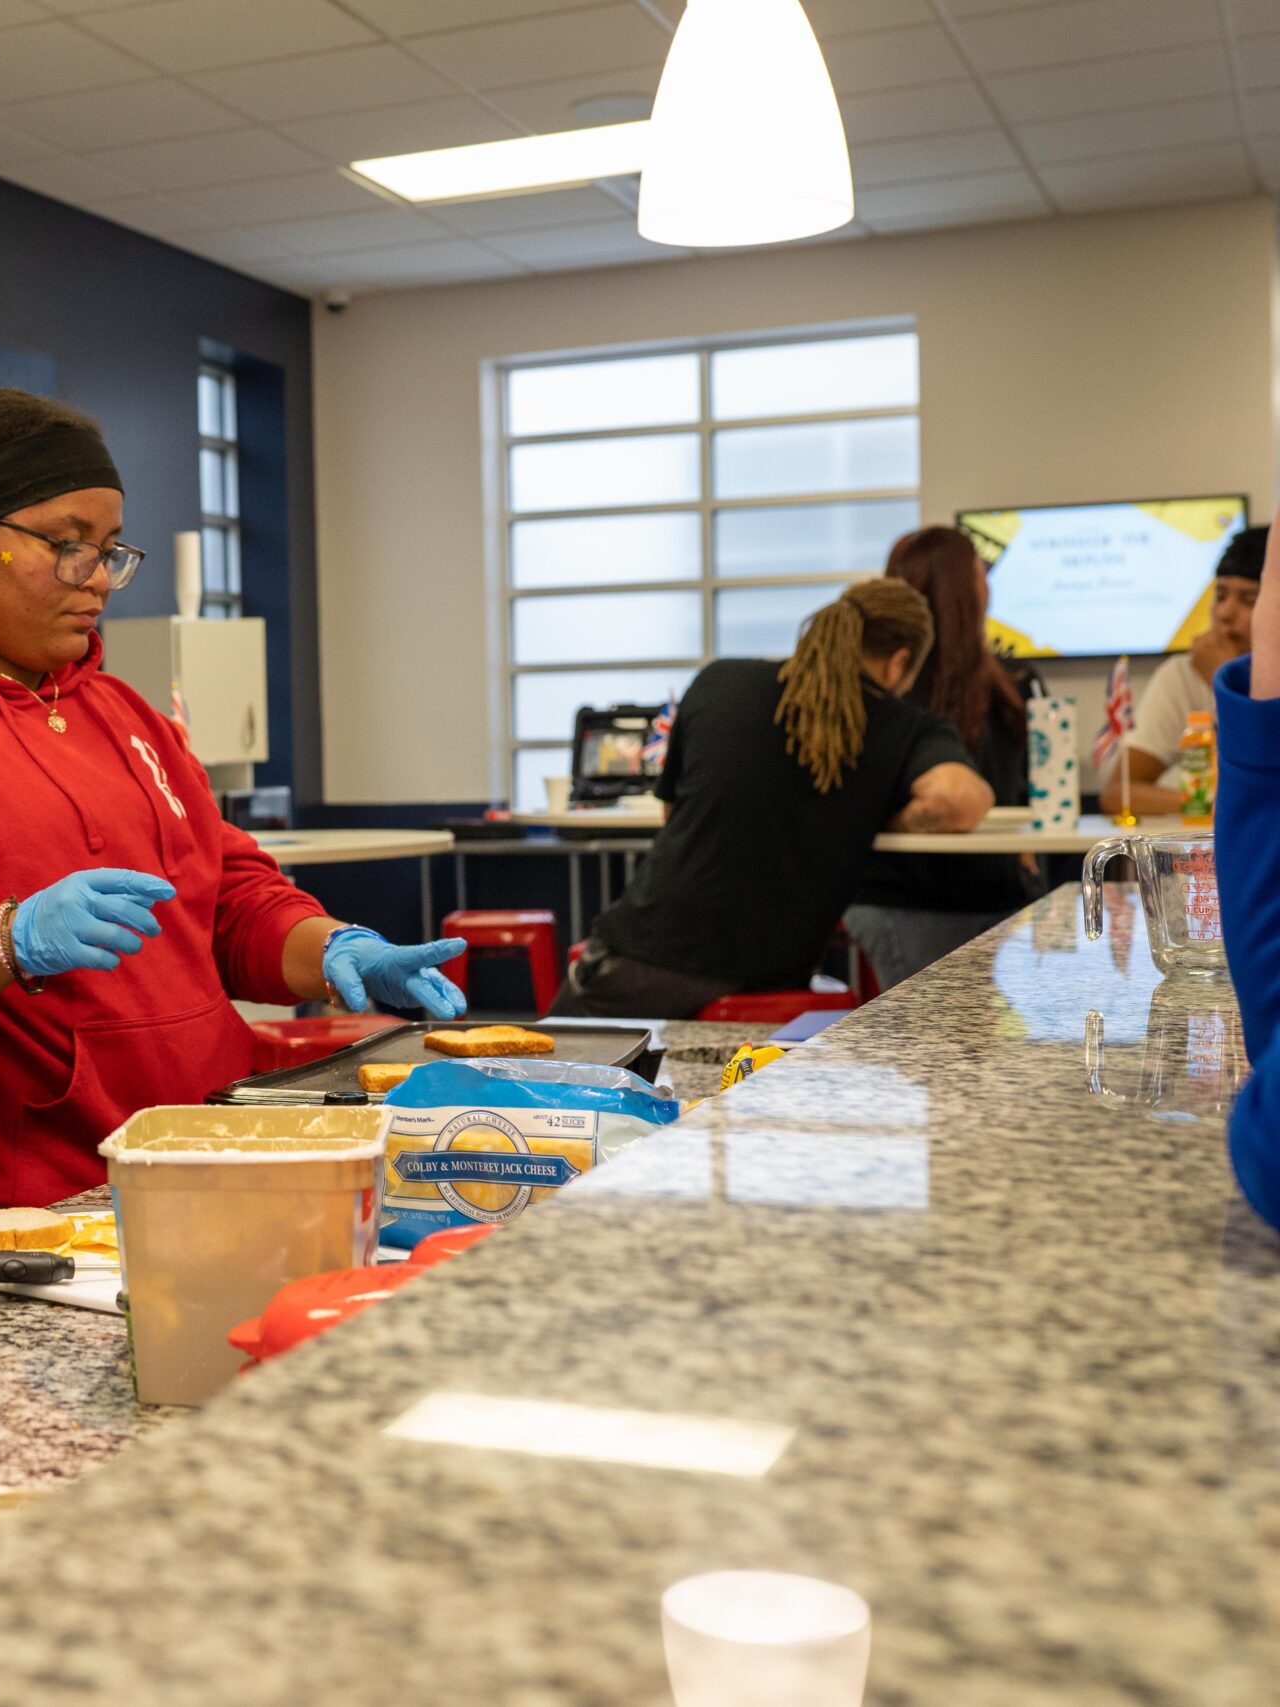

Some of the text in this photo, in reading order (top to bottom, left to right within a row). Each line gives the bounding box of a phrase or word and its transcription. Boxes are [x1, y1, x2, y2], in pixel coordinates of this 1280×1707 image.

[447, 1114, 517, 1139] NATURAL CHEESE
[546, 1116, 561, 1127] 42
[407, 1160, 558, 1177] COLBY & MONTEREY JACK CHEESE
